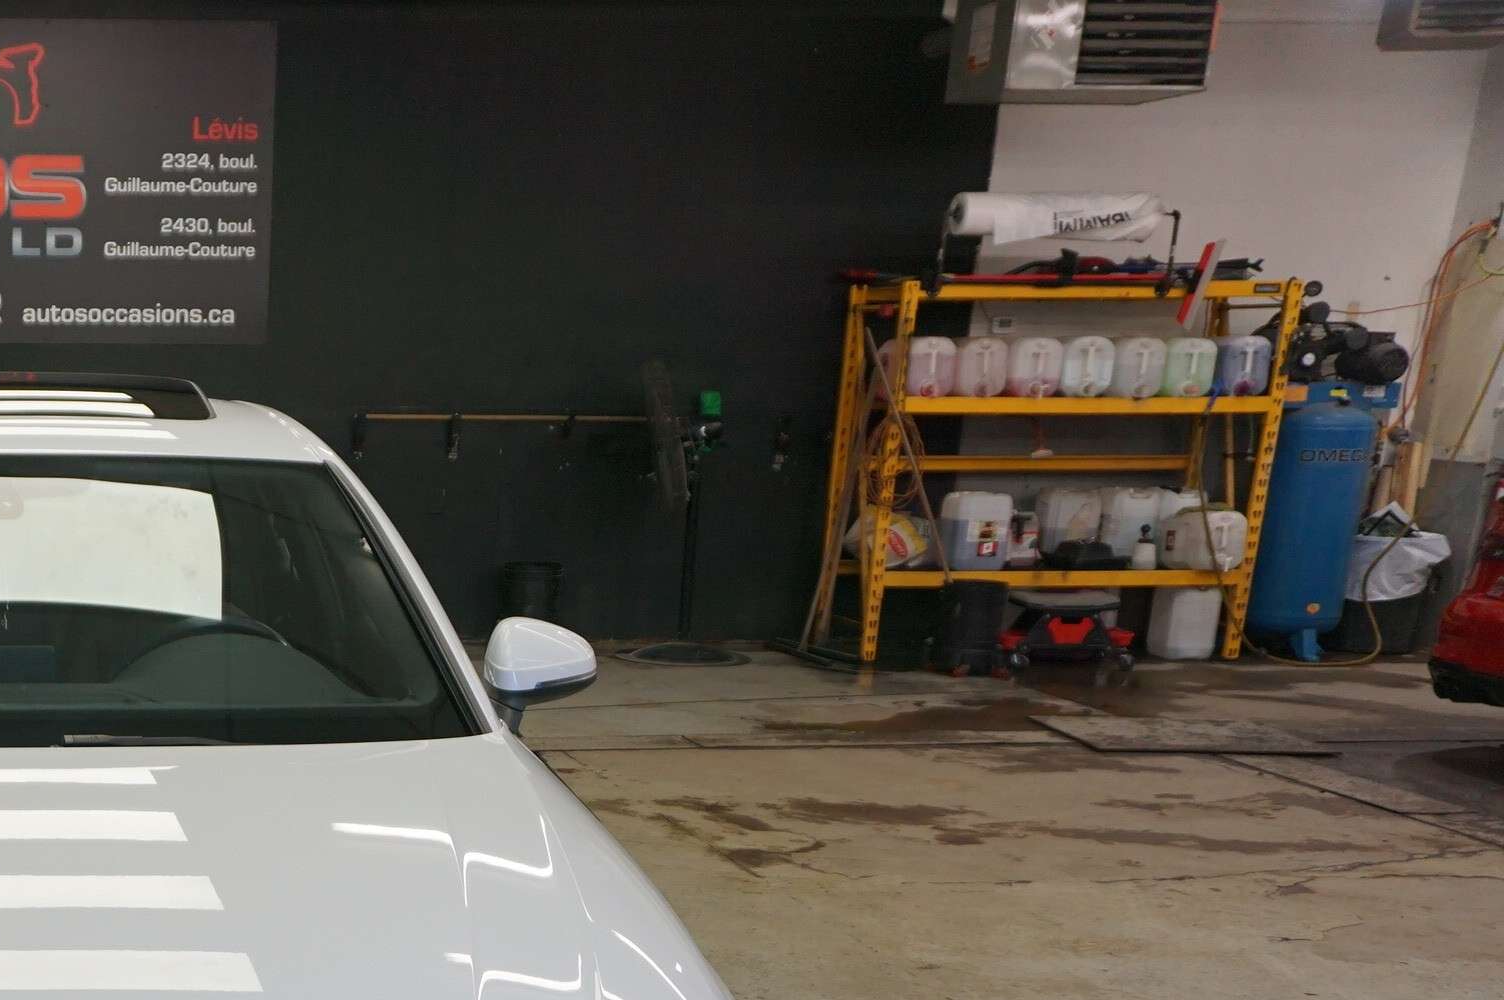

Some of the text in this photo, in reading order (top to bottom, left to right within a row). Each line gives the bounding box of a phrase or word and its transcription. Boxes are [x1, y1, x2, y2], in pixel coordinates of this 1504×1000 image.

[193, 116, 259, 141] Lévis
[161, 152, 258, 172] 2324, boul.
[104, 177, 258, 194] Guillaume-Couture
[160, 217, 256, 235] 2430, boul.
[12, 227, 84, 257] LD
[103, 241, 256, 259] Guillaume-Couture
[22, 302, 236, 325] autosoccasions.ca
